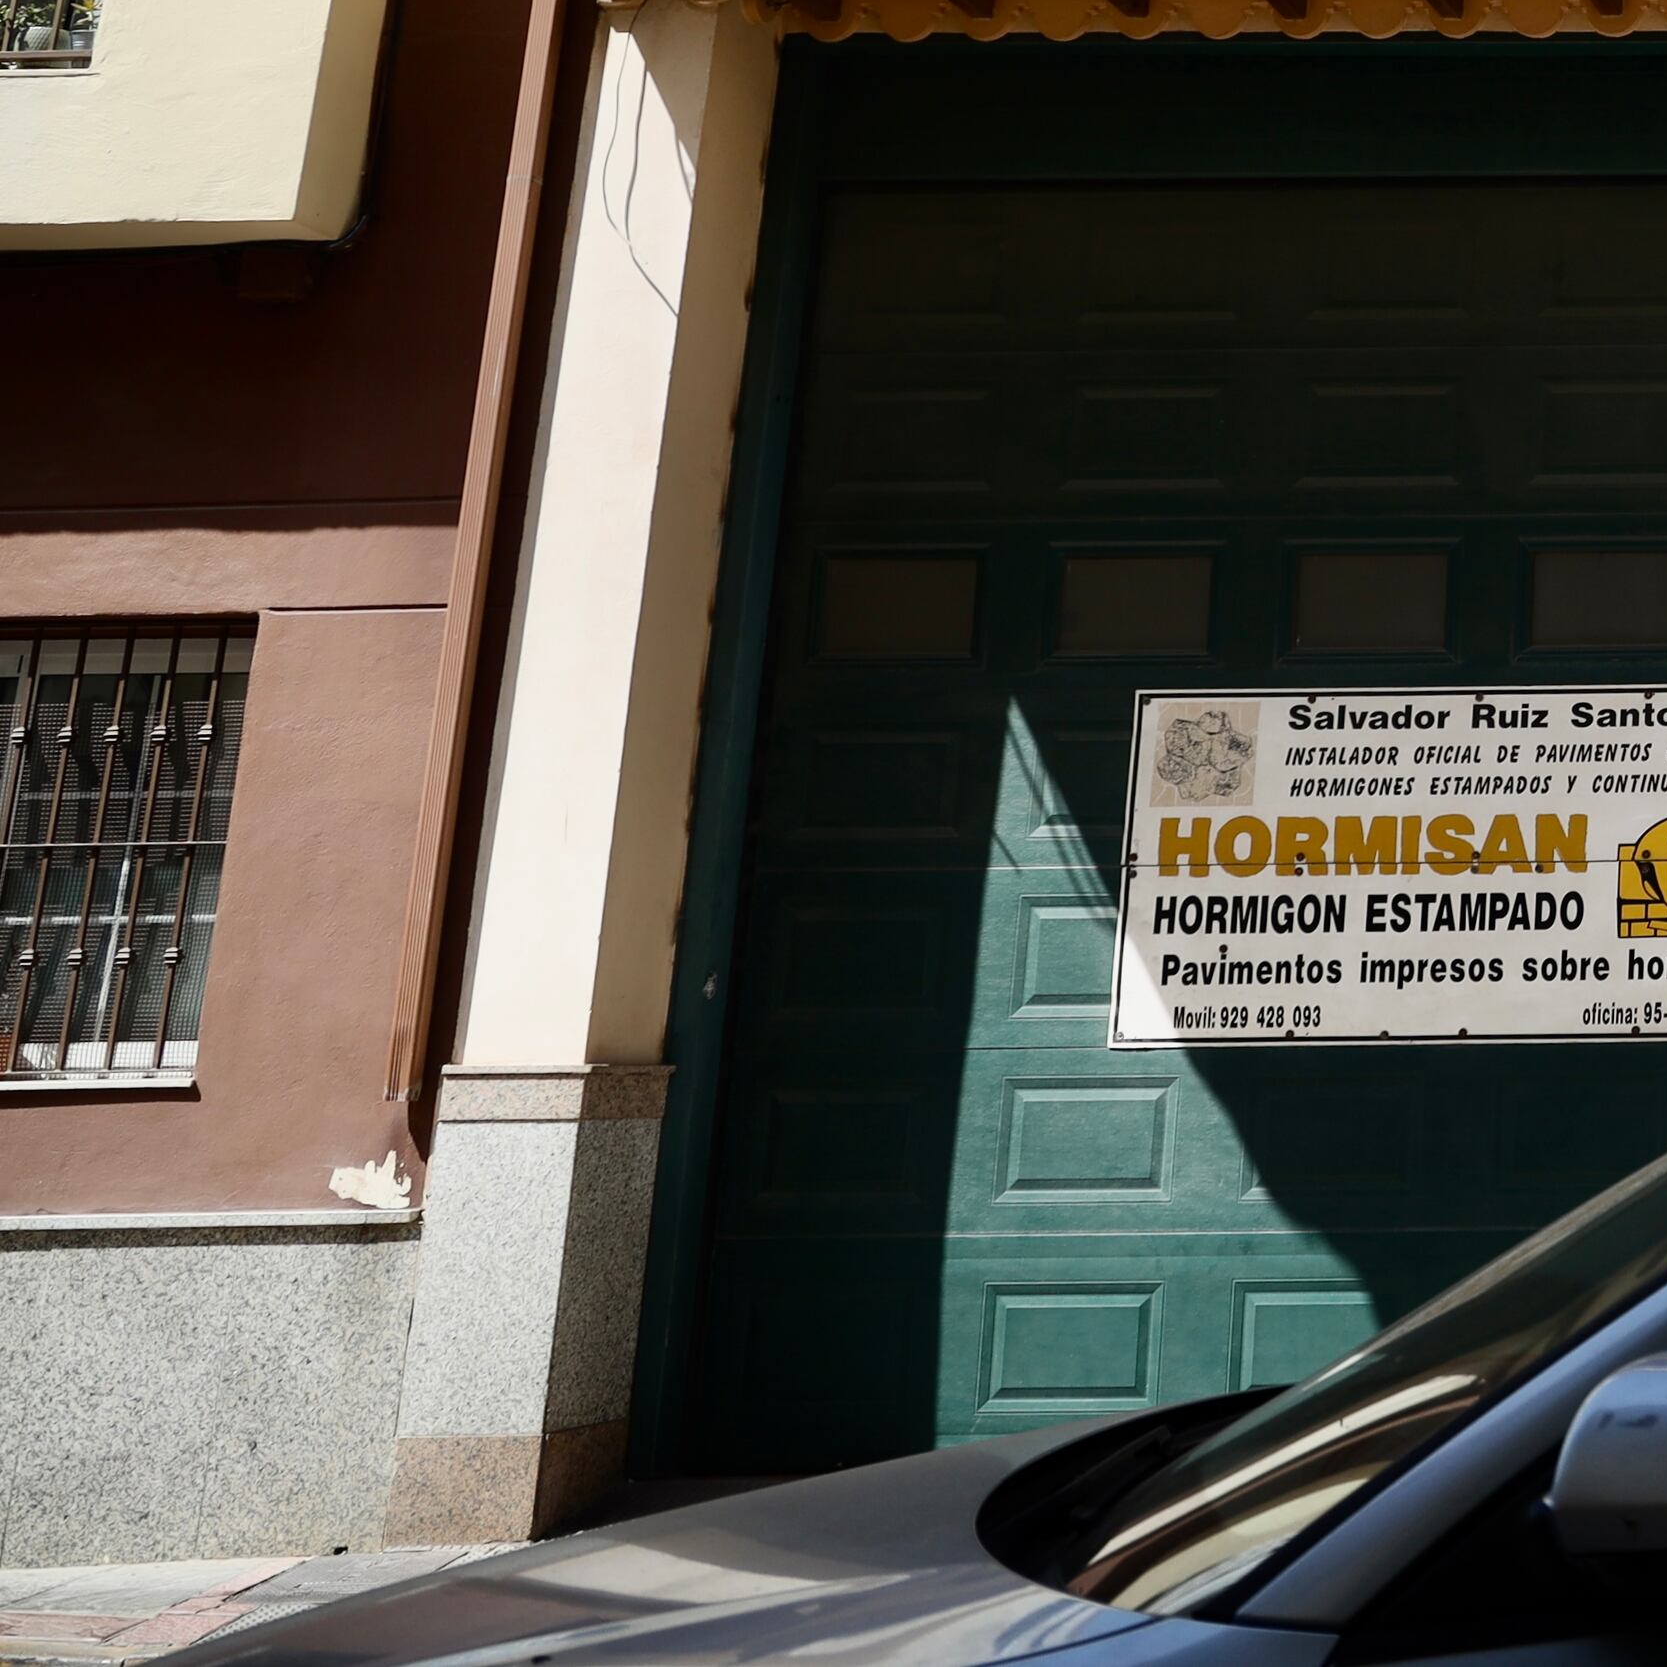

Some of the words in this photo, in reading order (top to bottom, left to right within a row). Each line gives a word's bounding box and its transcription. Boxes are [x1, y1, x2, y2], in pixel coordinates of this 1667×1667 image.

[1288, 704, 1451, 731] Salvador
[1471, 703, 1549, 729] Ruiz
[1285, 746, 1399, 766] INSTALADOR
[1413, 745, 1481, 765] OFICIAL
[1496, 744, 1521, 764] DE
[1535, 742, 1653, 763] PAVIMENTOS
[1289, 776, 1416, 798] HORMIGONES
[1429, 775, 1553, 796] ESTAMPADOS
[1567, 775, 1578, 794] Y
[1158, 814, 1588, 878] HORMISAN
[1153, 893, 1347, 935] HORMIGON
[1365, 890, 1585, 933] ESTAMPADO
[1161, 950, 1342, 986] Pavimentos
[1360, 951, 1504, 990] impresos
[1522, 949, 1610, 982] sobre
[1173, 1006, 1216, 1029] Movil:
[1220, 1006, 1249, 1029] 929
[1256, 1005, 1285, 1028] 428
[1292, 1005, 1321, 1028] 093
[1582, 1002, 1638, 1026] oficina:
